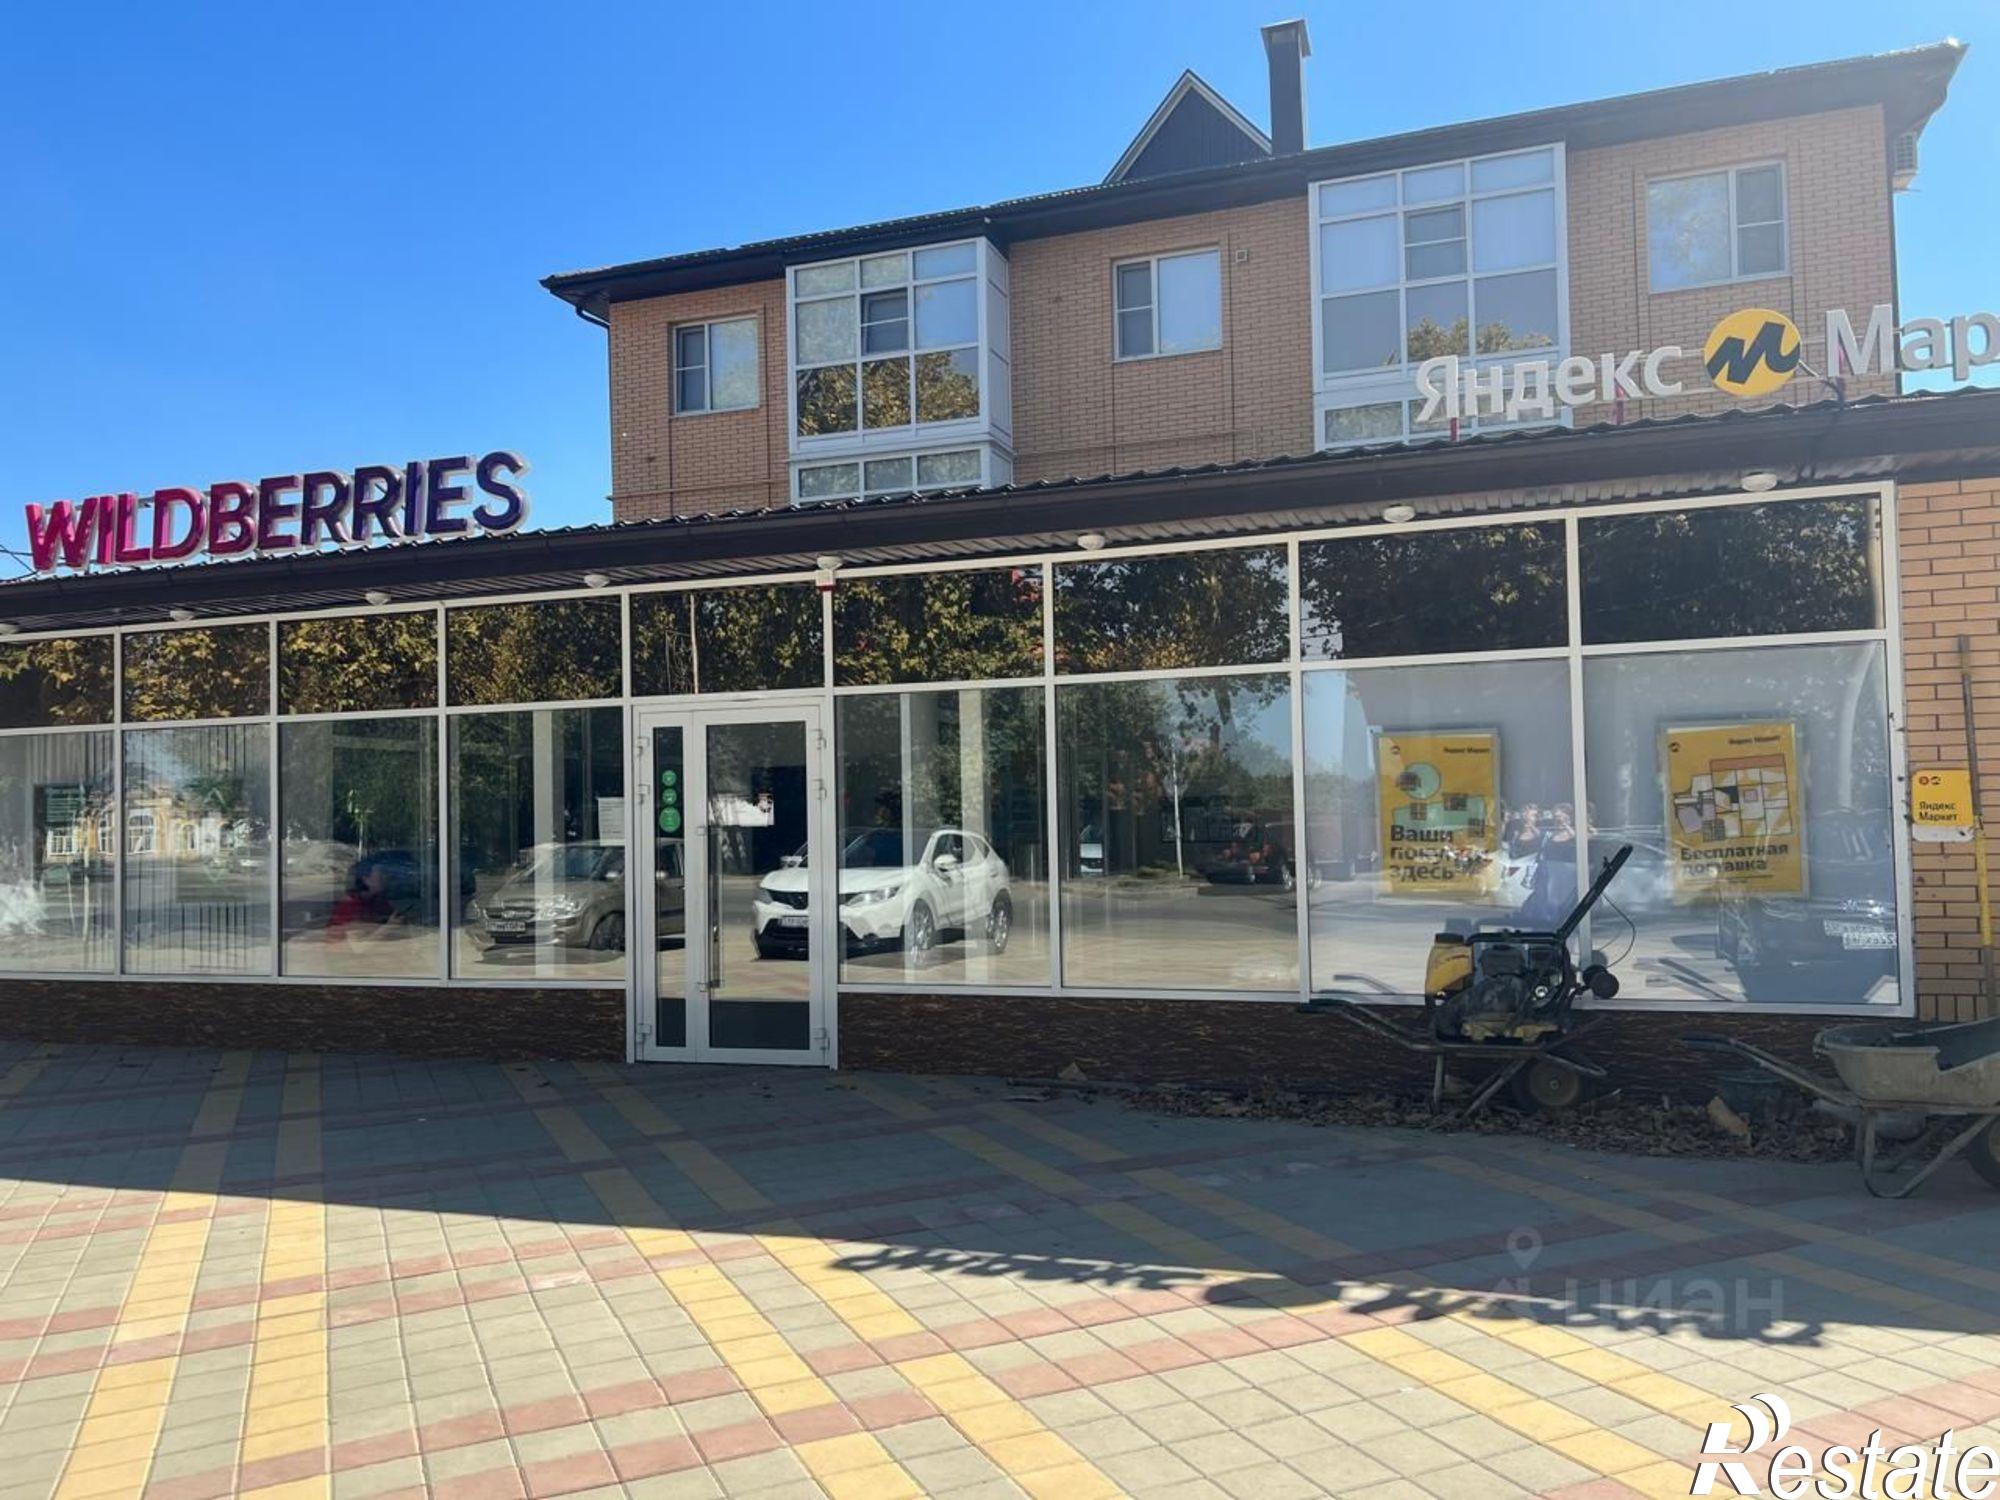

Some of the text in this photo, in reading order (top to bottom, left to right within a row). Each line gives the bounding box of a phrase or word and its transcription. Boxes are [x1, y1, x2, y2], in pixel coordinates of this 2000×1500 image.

[1414, 303, 2000, 422] Яндекс Мар
[25, 450, 529, 573] WILDBERRIES
[1919, 801, 1956, 811] Яндекс
[1919, 811, 1958, 821] Маркет
[1390, 824, 1453, 843] Ваши
[1680, 844, 1788, 861] Бесплатная
[1389, 865, 1454, 882] здесь
